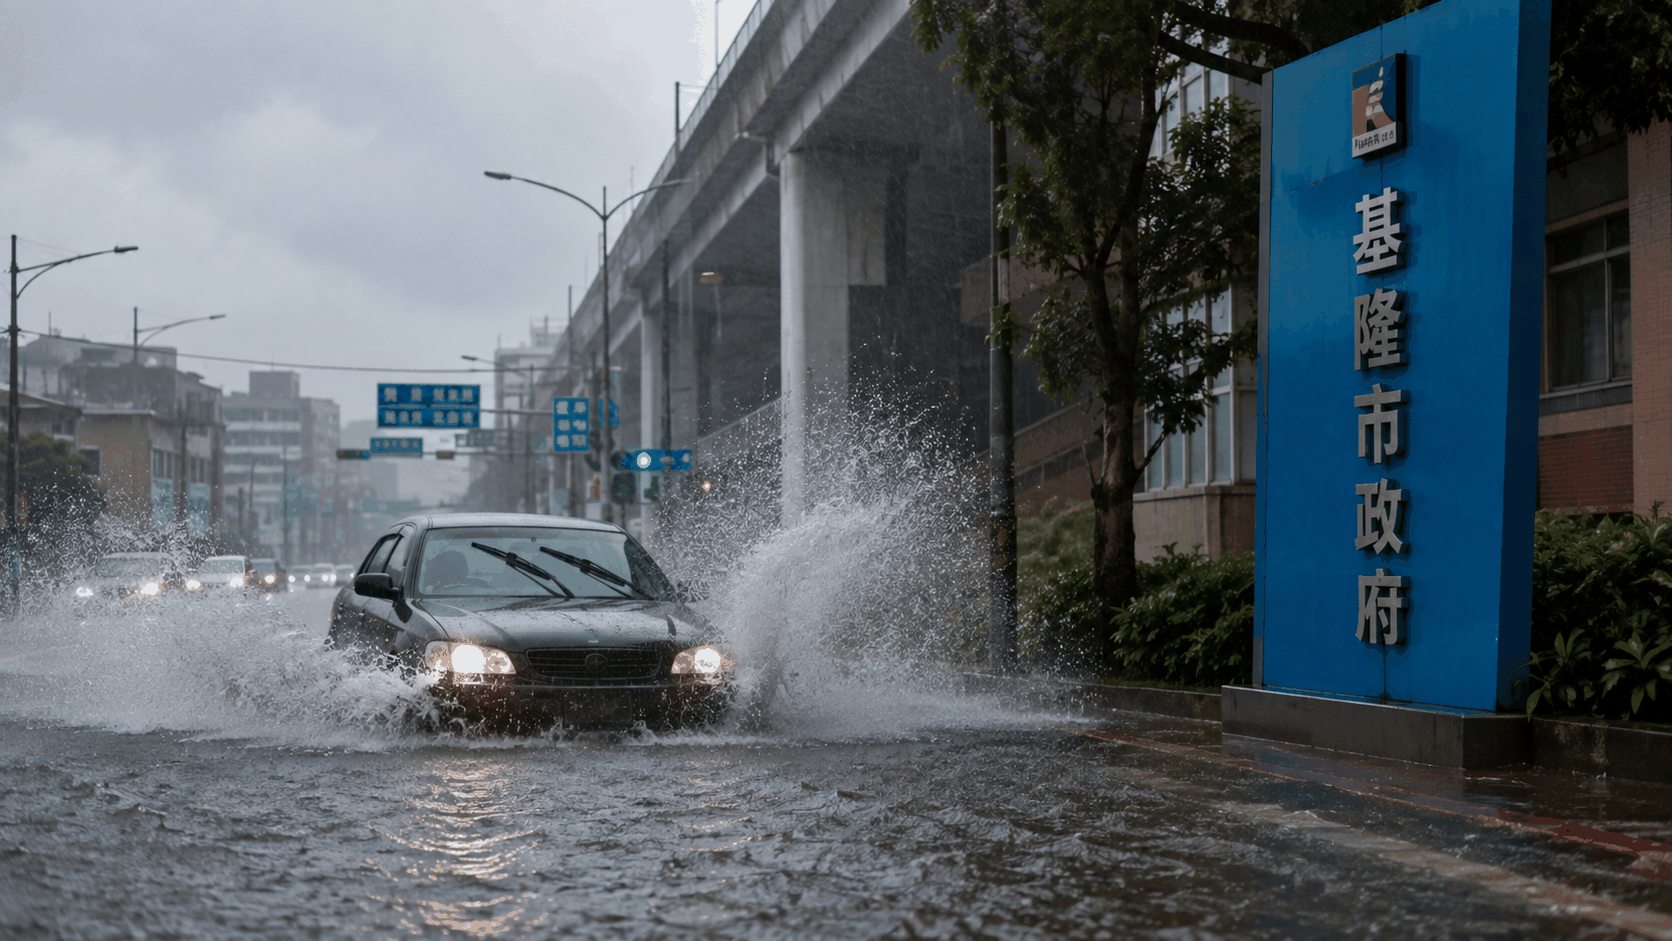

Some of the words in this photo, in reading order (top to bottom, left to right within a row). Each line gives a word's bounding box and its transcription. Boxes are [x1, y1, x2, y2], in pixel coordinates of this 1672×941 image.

[1353, 186, 1403, 646] 基隆市政府
